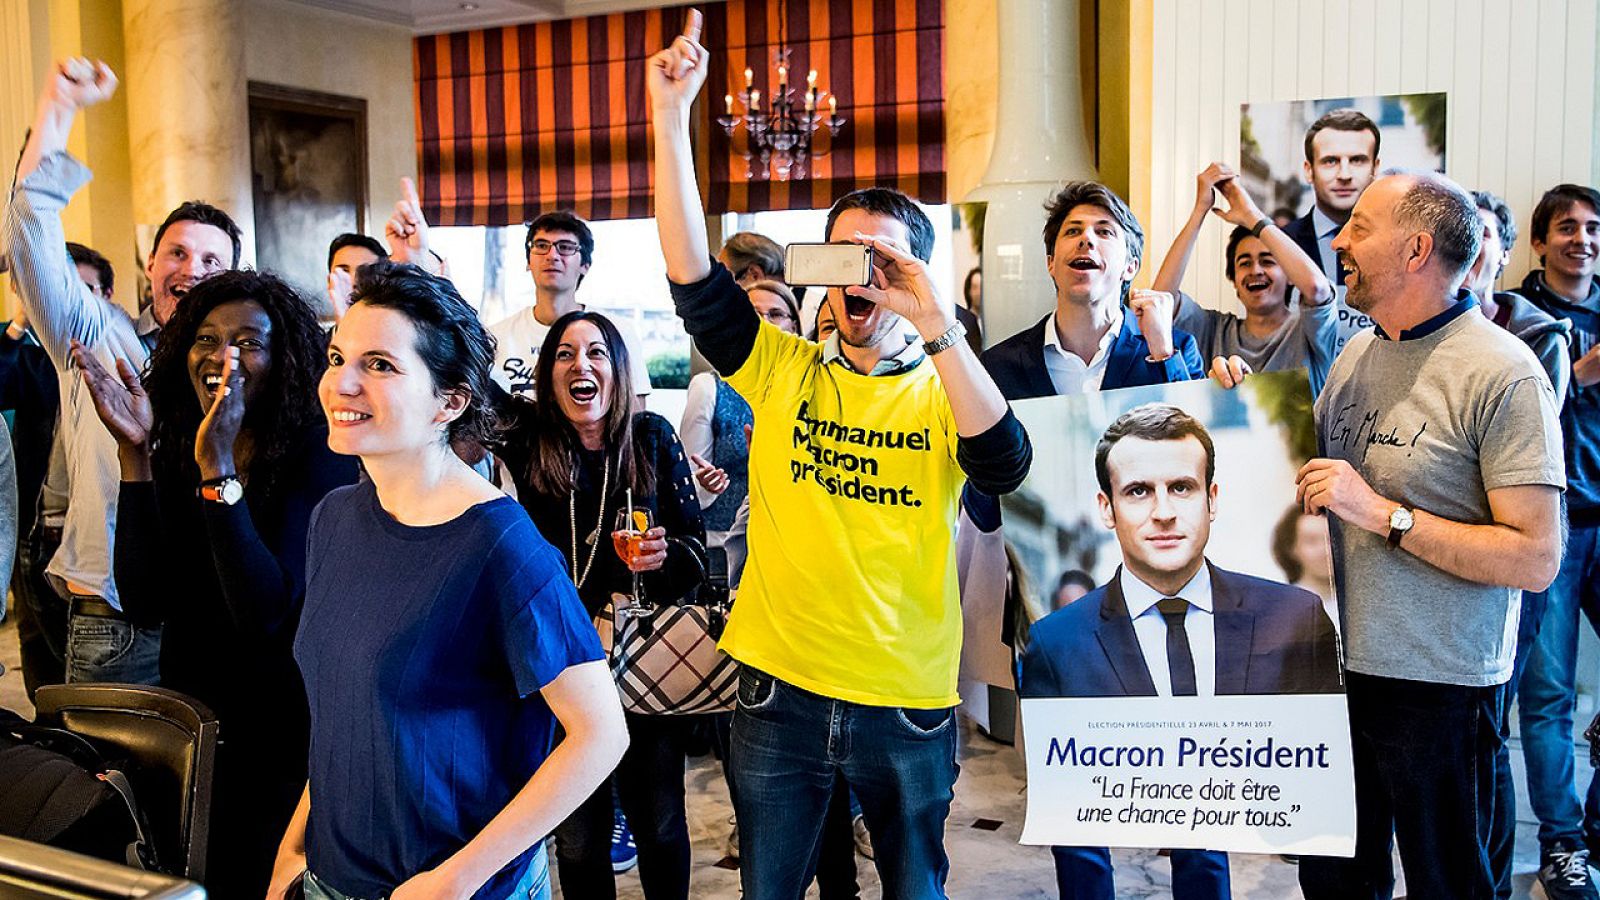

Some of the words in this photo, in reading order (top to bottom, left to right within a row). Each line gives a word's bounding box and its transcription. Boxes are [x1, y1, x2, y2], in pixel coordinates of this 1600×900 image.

[1330, 404, 1357, 451] En
[793, 426, 878, 476] Macron
[1046, 737, 1163, 767] Macron
[1178, 737, 1329, 768] Président
[1130, 777, 1193, 800] France
[1199, 777, 1236, 801] doit
[1241, 778, 1280, 801] être
[1077, 807, 1112, 822] une
[1117, 802, 1186, 825] chance
[1191, 809, 1240, 831] pour
